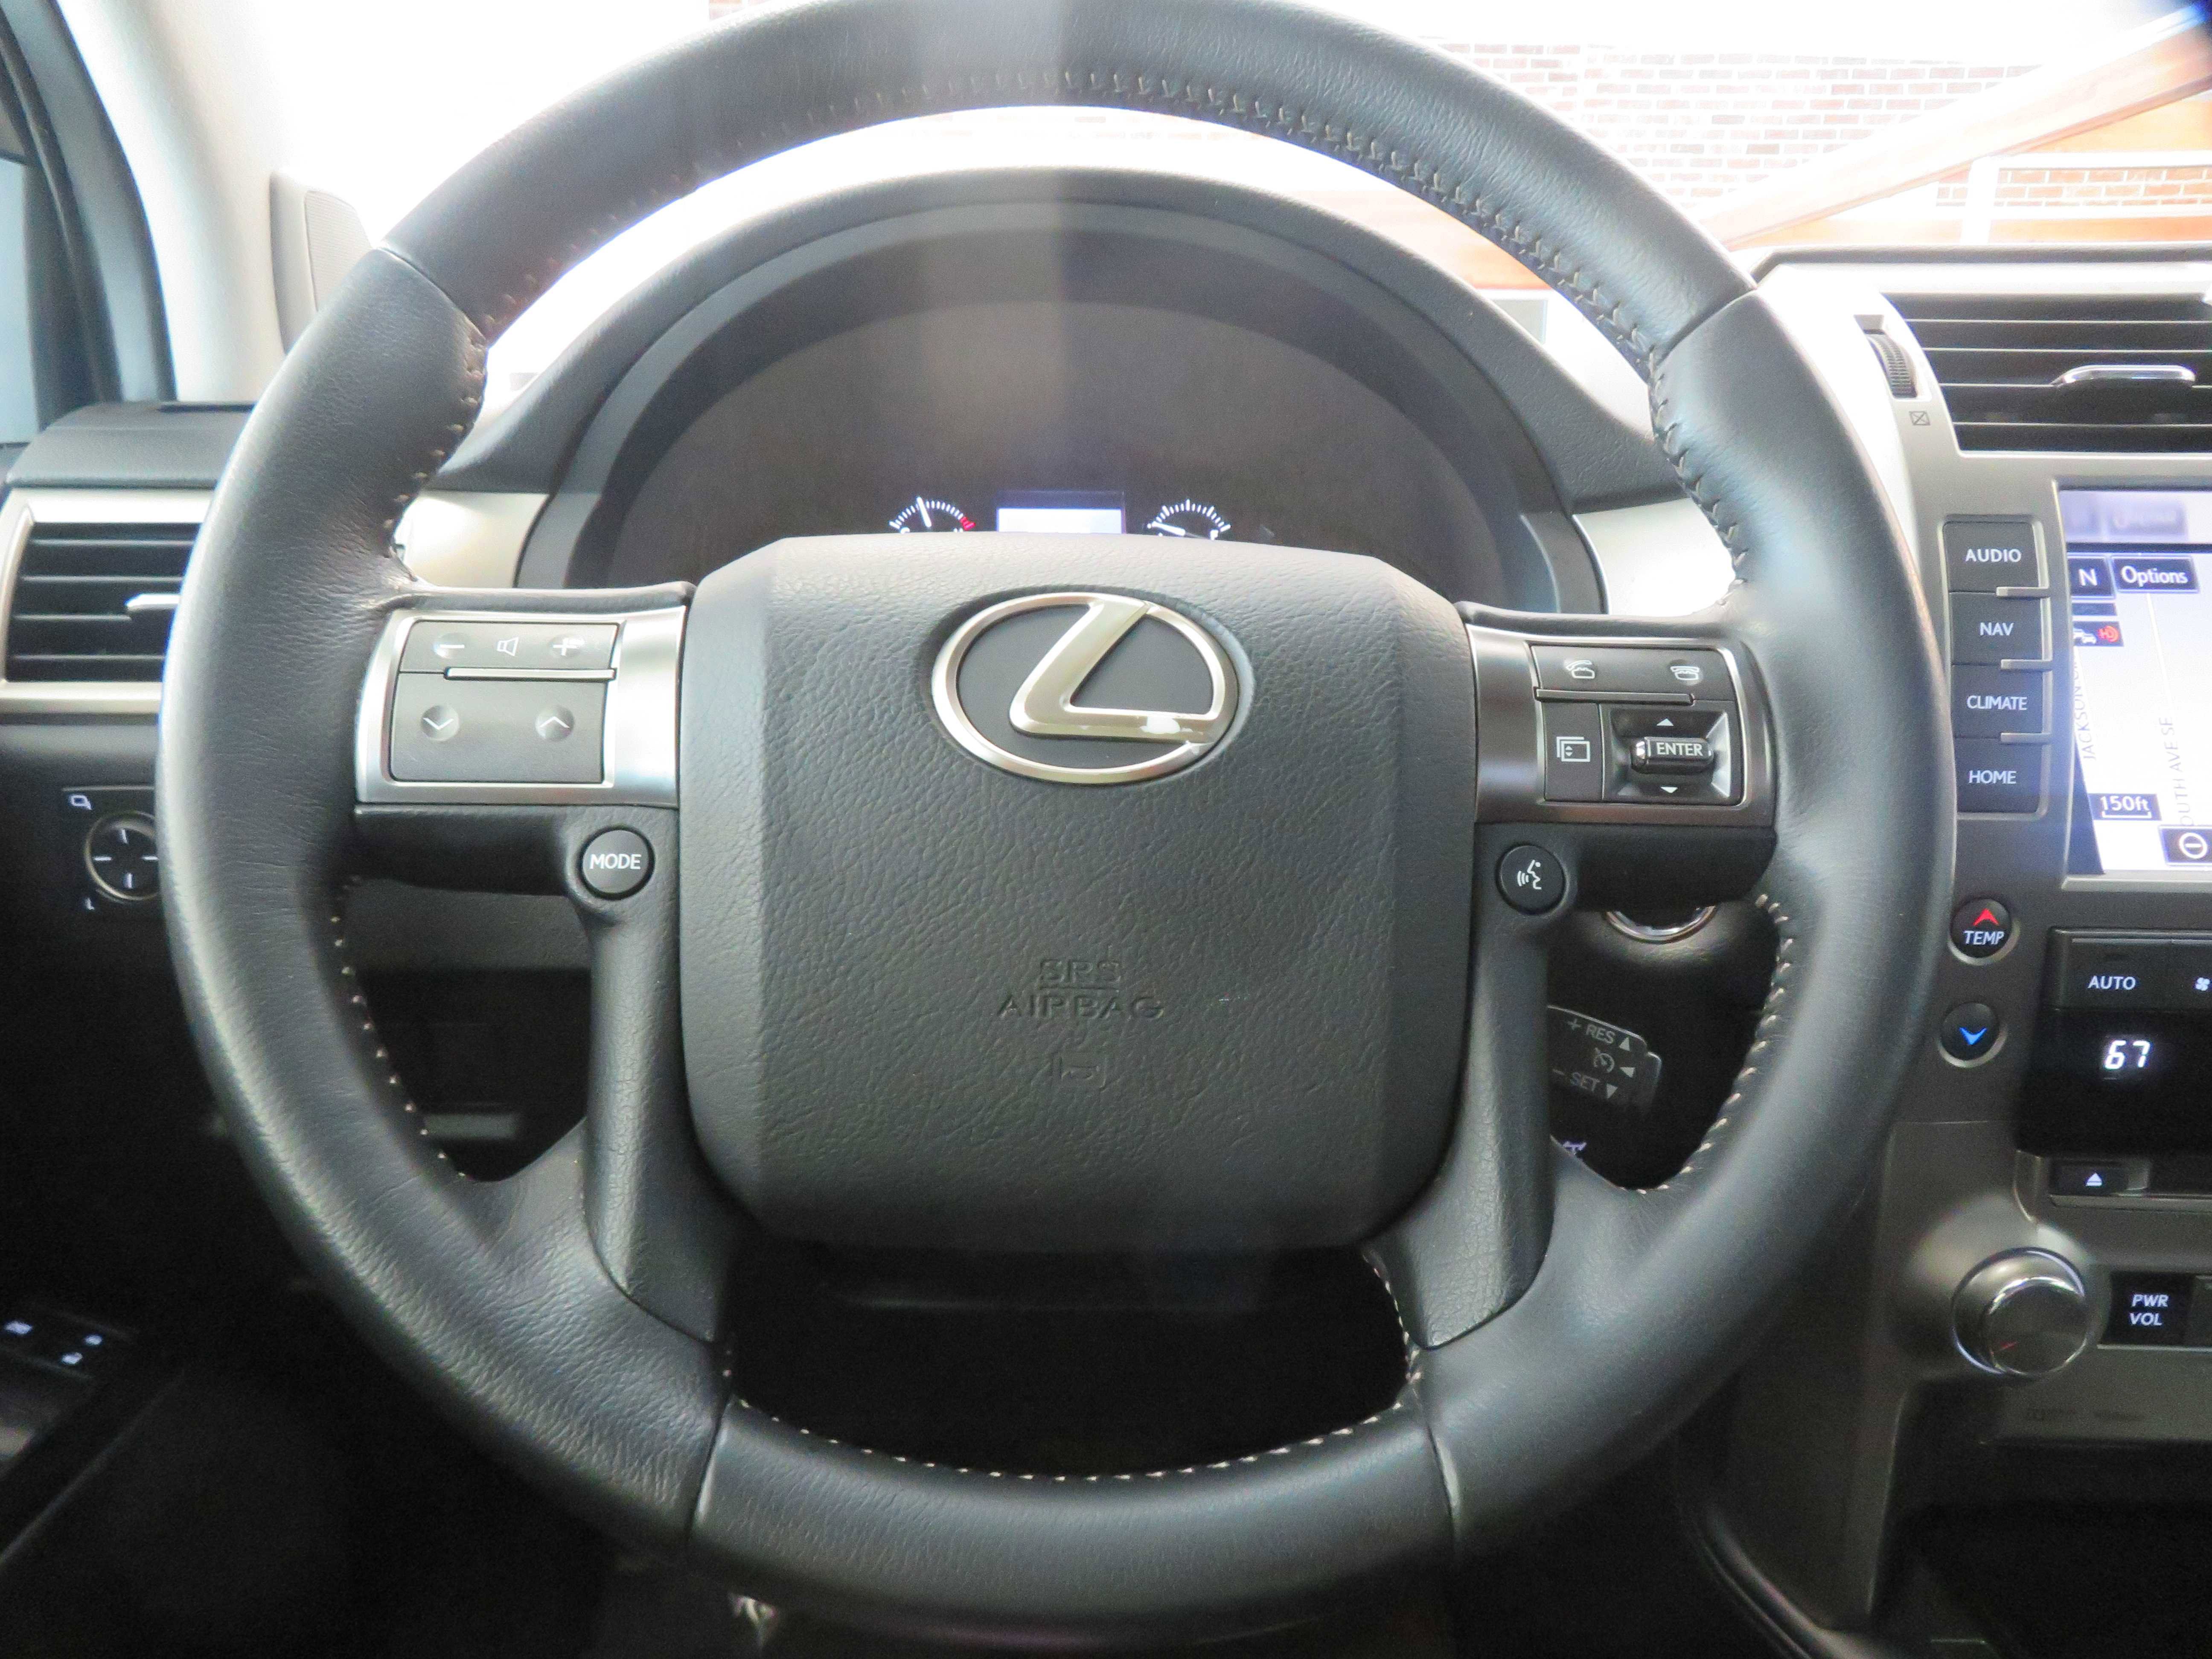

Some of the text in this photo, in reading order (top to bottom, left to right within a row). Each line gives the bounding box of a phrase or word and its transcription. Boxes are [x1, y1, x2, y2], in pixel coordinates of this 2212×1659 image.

[1965, 548, 2022, 563] AUDIO
[2078, 568, 2098, 586] N
[2121, 565, 2189, 587] Options
[1979, 622, 2014, 636] NAV
[1966, 695, 2027, 710] CLIMATE
[2073, 686, 2096, 761] JACKSON
[1656, 742, 1704, 757] ENTER
[2163, 741, 2183, 772] AVE
[1968, 770, 2017, 784] HOME
[2100, 795, 2150, 811] 150ft
[2172, 778, 2194, 826] OUTH
[590, 853, 642, 869] MODE
[1963, 930, 2005, 945] TEMP
[1039, 958, 1121, 983] SRS
[2087, 975, 2136, 990] AUTO
[996, 994, 1165, 1020] AIRBAG
[1585, 1024, 1616, 1044] RES
[2104, 1039, 2151, 1070] 67
[1569, 1071, 1601, 1091] SET
[2131, 1294, 2169, 1307] PWR
[2130, 1312, 2163, 1326] VOL
